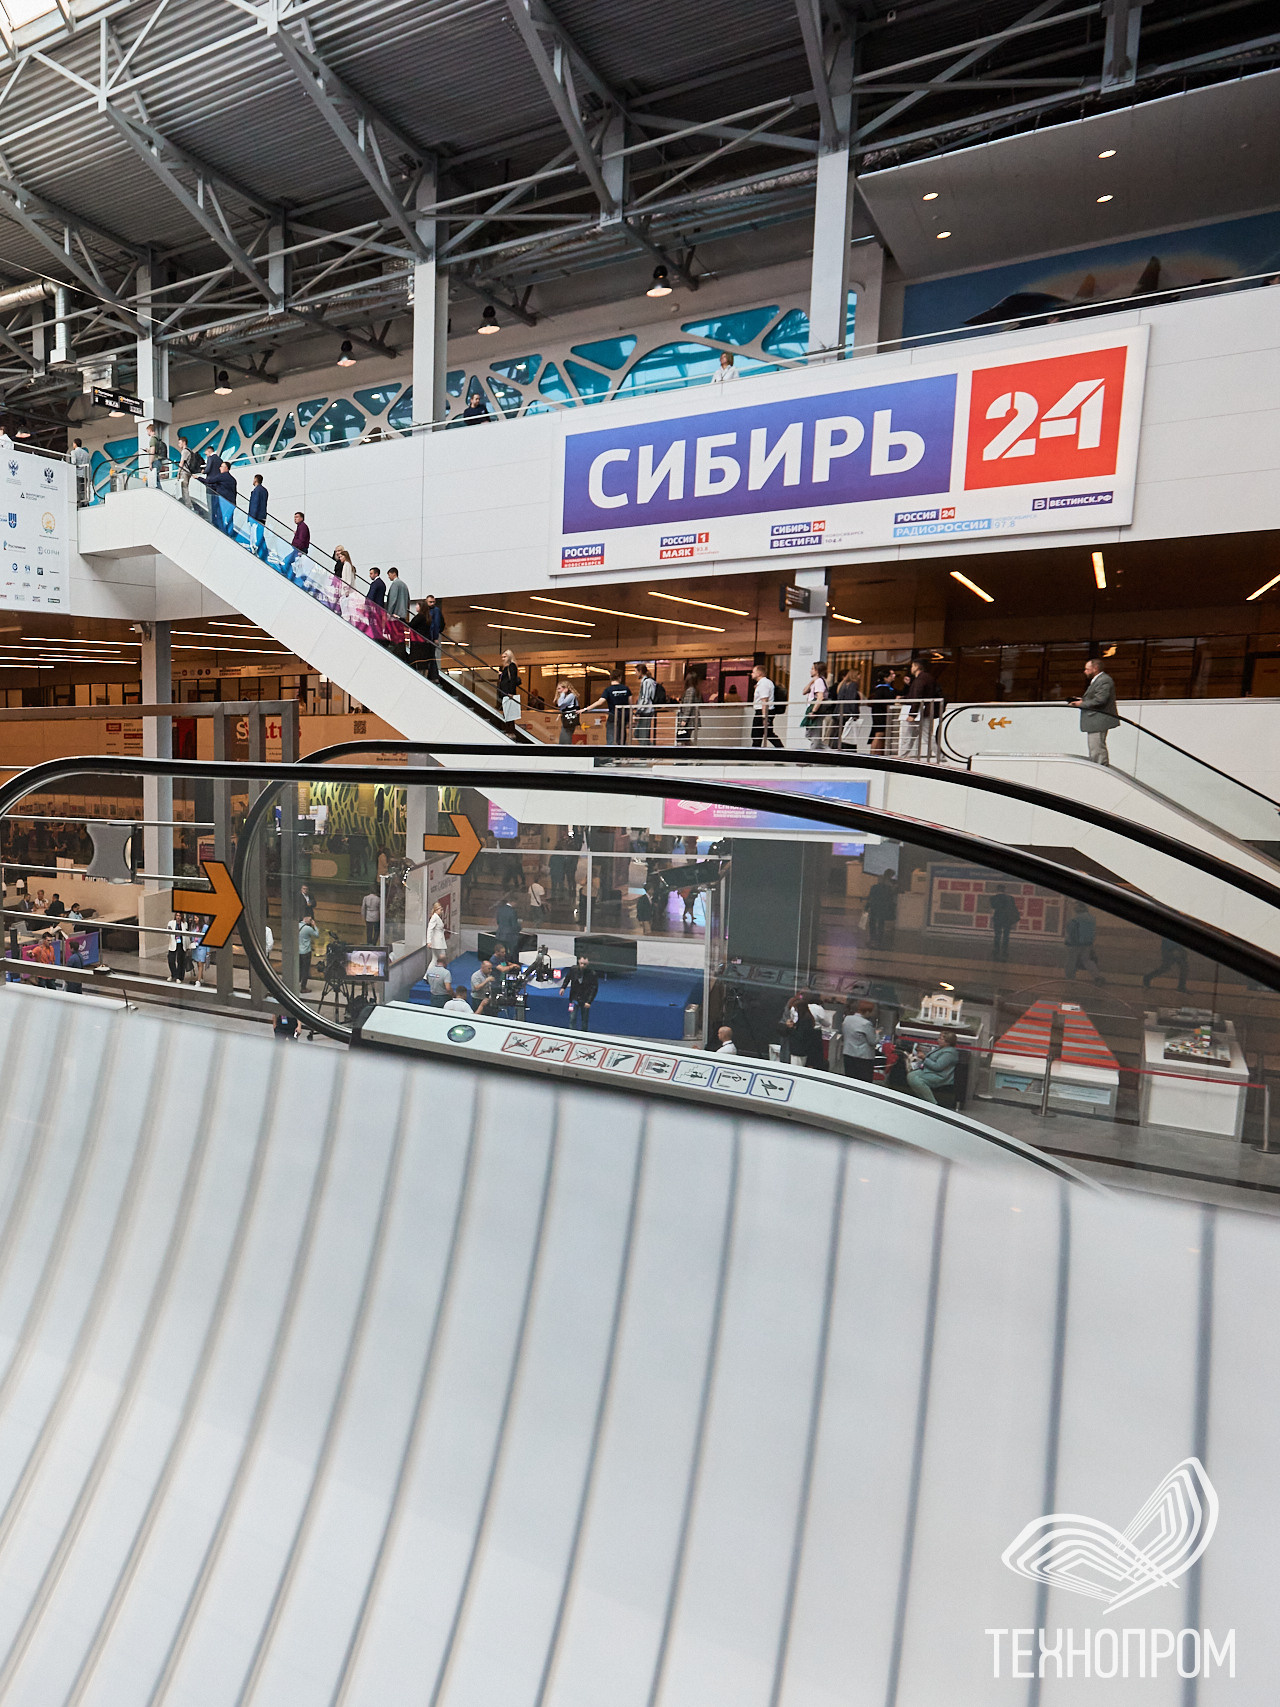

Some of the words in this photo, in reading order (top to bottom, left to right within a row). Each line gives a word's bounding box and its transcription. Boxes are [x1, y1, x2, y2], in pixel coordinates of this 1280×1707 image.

[588, 409, 925, 510] СИБИРЬ
[982, 378, 1106, 462] 24
[1049, 494, 1113, 508] ВЕСТИНСК.РФ
[897, 511, 937, 522] РОССИЯ
[941, 509, 955, 519] 24
[773, 524, 809, 535] СИБИРЬ
[813, 521, 825, 532] 24
[662, 536, 695, 546] РОССИЯ
[564, 546, 602, 558] РОССИЯ
[662, 548, 692, 559] МАЯК
